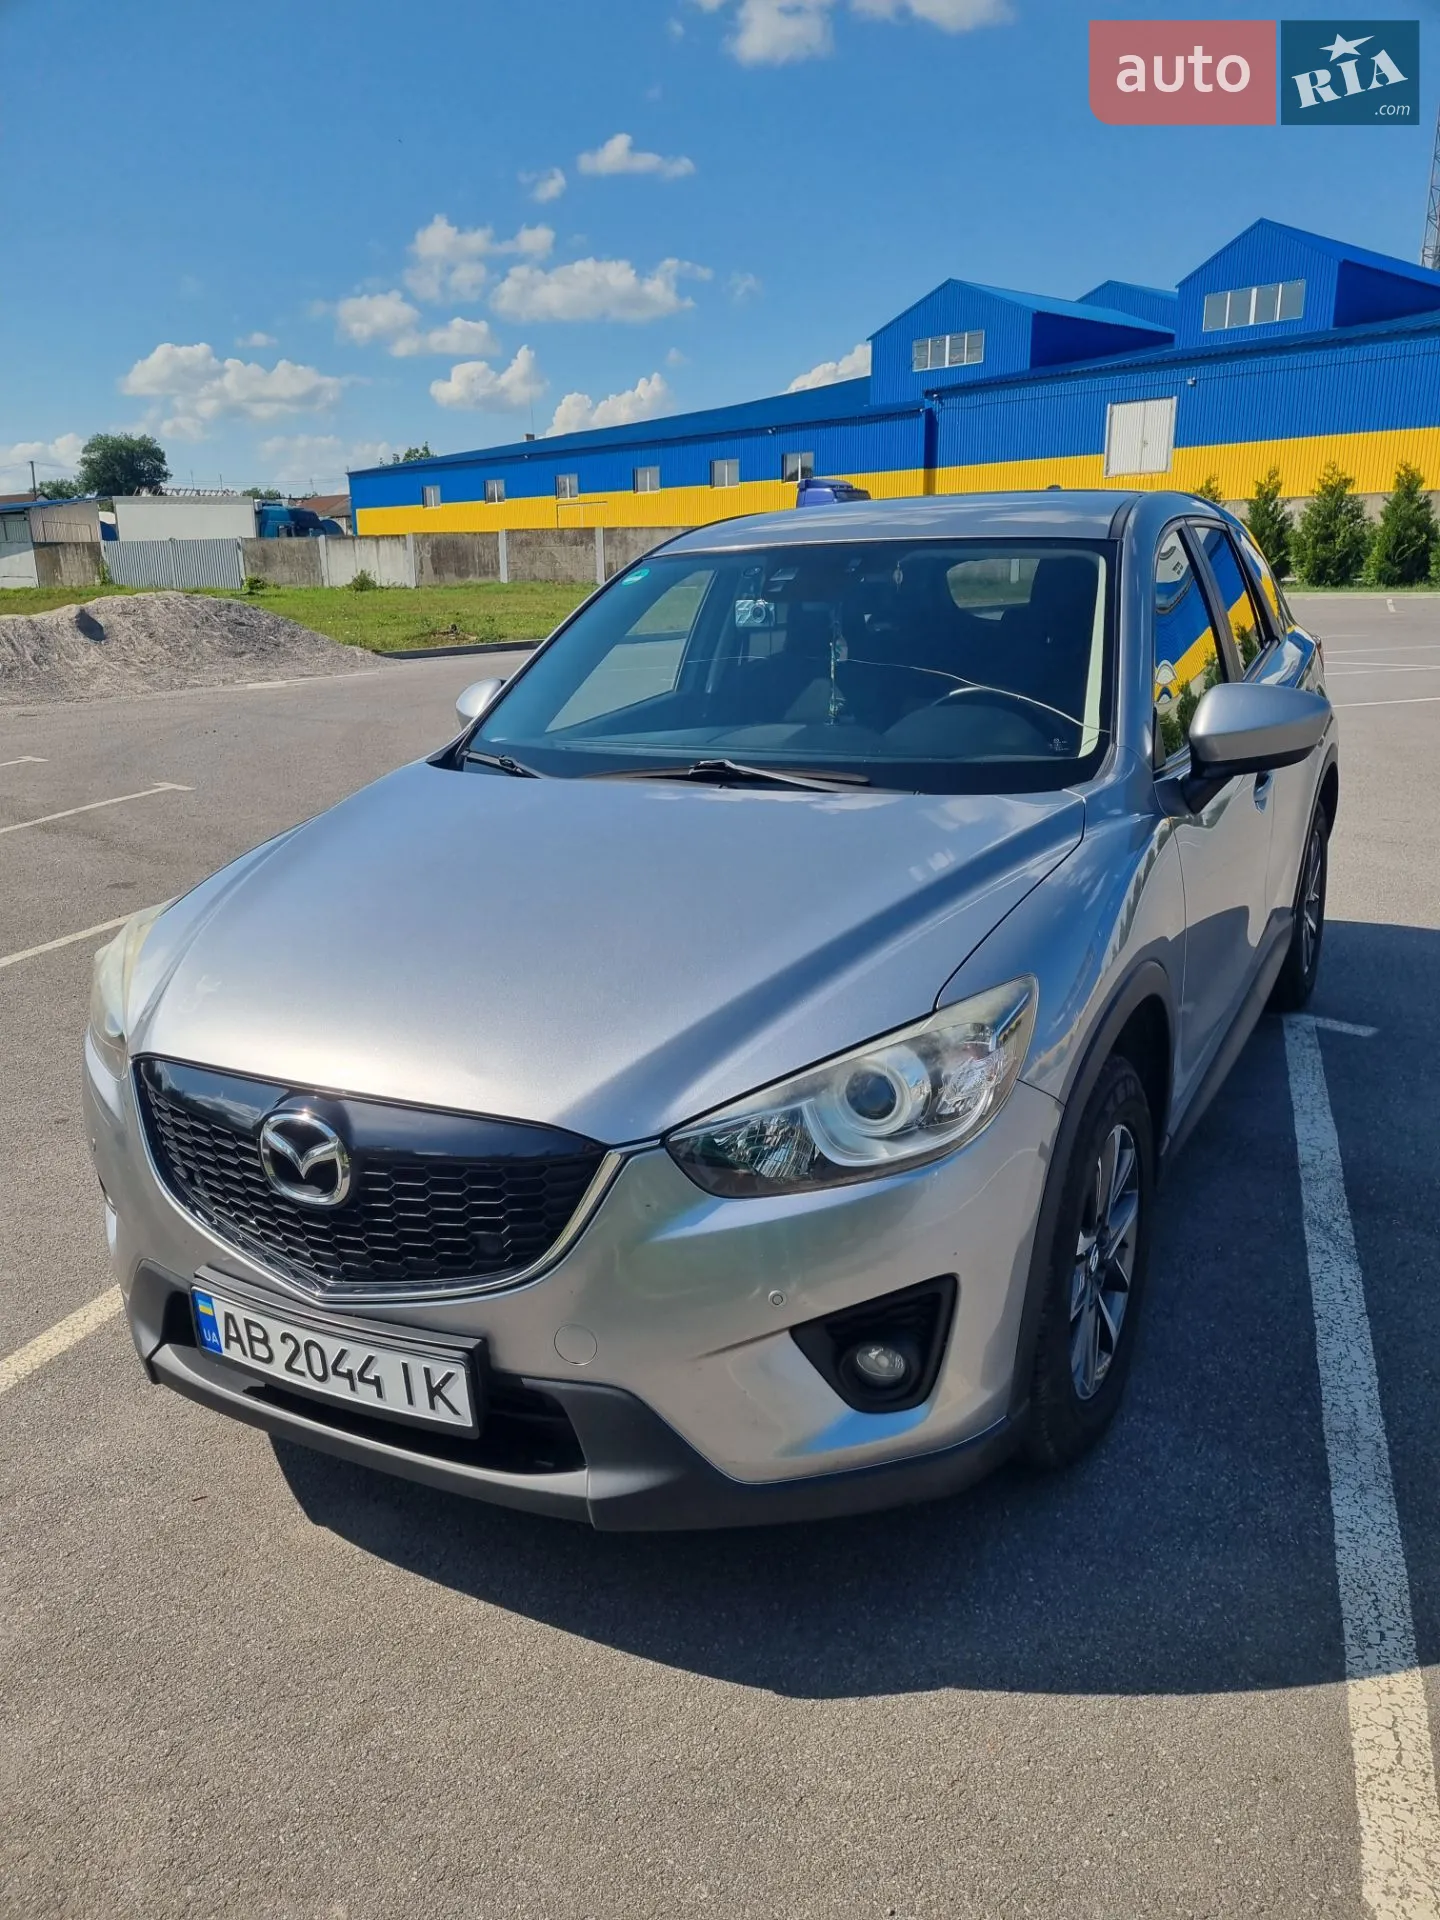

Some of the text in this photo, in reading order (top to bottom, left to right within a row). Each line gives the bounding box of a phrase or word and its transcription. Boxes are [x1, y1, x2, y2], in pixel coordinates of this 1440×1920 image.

[203, 1328, 219, 1345] UA
[224, 1311, 461, 1416] AB 2044 IK
